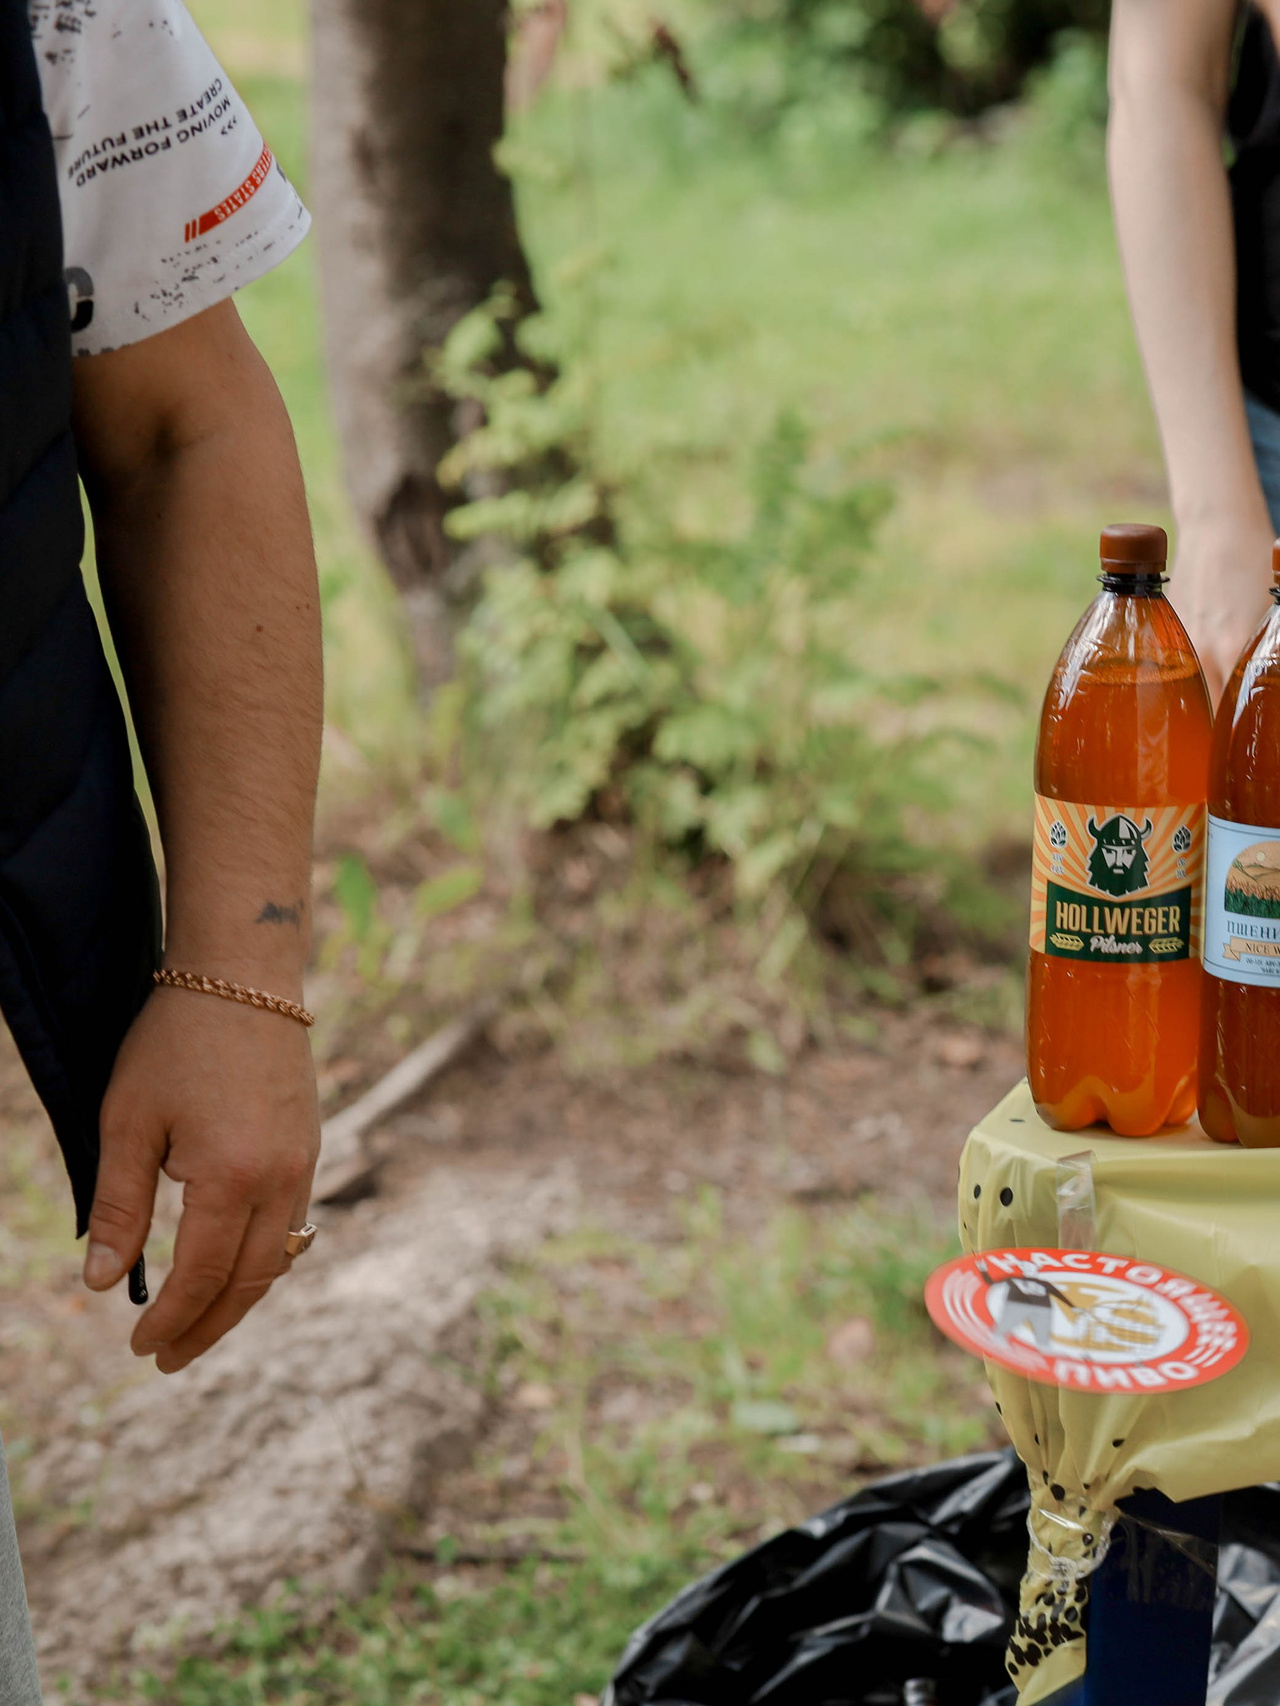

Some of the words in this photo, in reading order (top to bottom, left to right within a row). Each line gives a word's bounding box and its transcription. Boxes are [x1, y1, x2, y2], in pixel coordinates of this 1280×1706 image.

[175, 77, 223, 124] CREATE
[176, 95, 231, 142] MOVING
[132, 115, 172, 142] THE
[67, 132, 126, 180] FUTURE
[75, 136, 172, 187] FORWARD
[214, 179, 254, 221] STATES
[1055, 900, 1181, 936] HOLLWEGER
[1089, 934, 1144, 955] Pilsner
[1245, 942, 1271, 954] NICE
[1053, 1360, 1199, 1389] ПИВО
